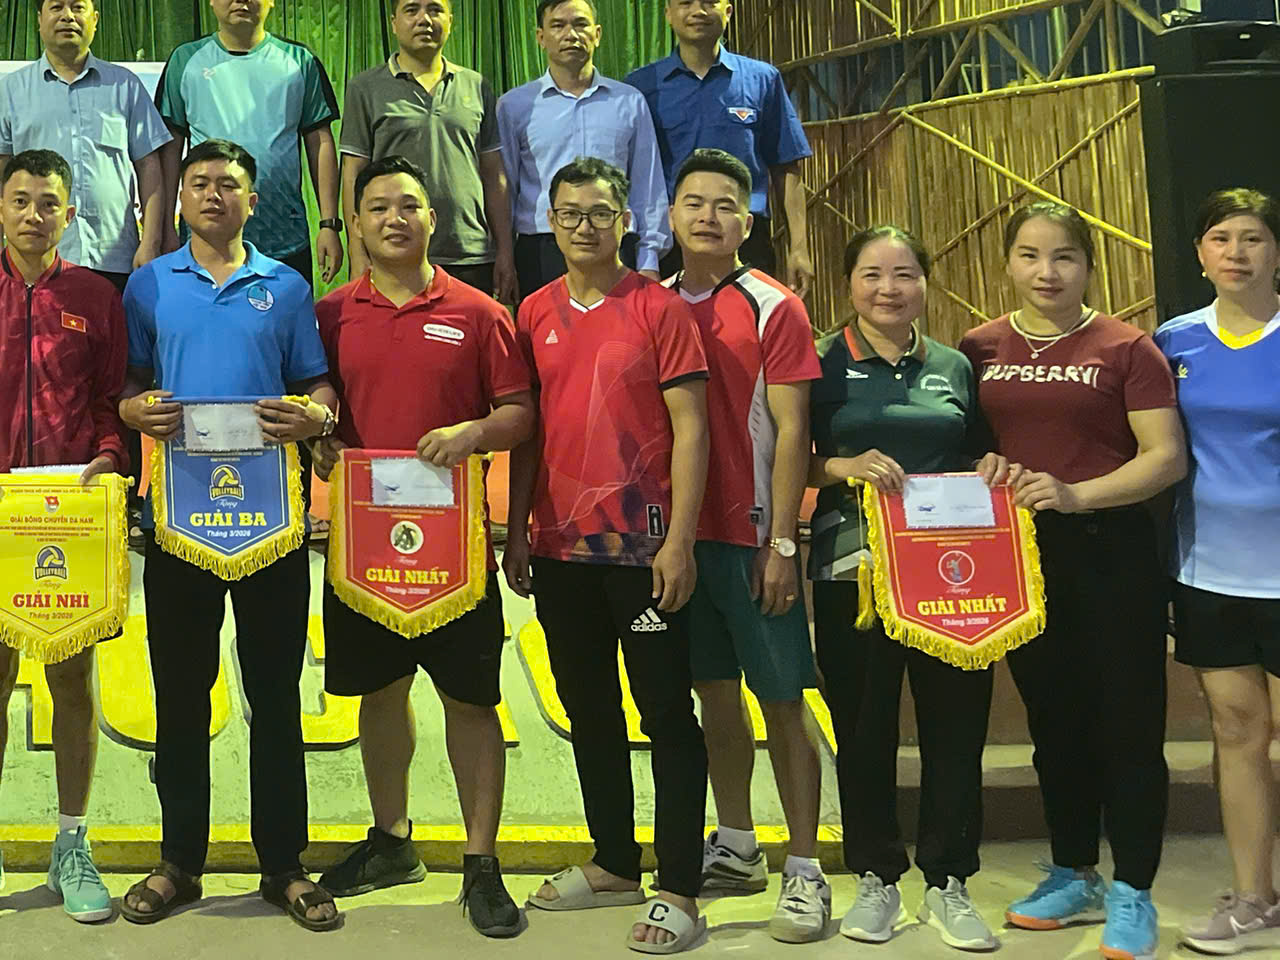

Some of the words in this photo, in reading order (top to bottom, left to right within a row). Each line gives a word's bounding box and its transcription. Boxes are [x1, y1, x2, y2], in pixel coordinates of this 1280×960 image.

[190, 509, 233, 527] GIẢI
[239, 512, 267, 527] BA
[366, 565, 401, 583] GIẢI
[404, 566, 450, 585] NHẤT
[13, 590, 51, 609] GIẢI
[56, 591, 89, 609] NHÌ
[917, 596, 956, 616] GIẢI
[959, 593, 1007, 614] NHẤT
[630, 622, 668, 632] adidas
[648, 903, 670, 922] C
